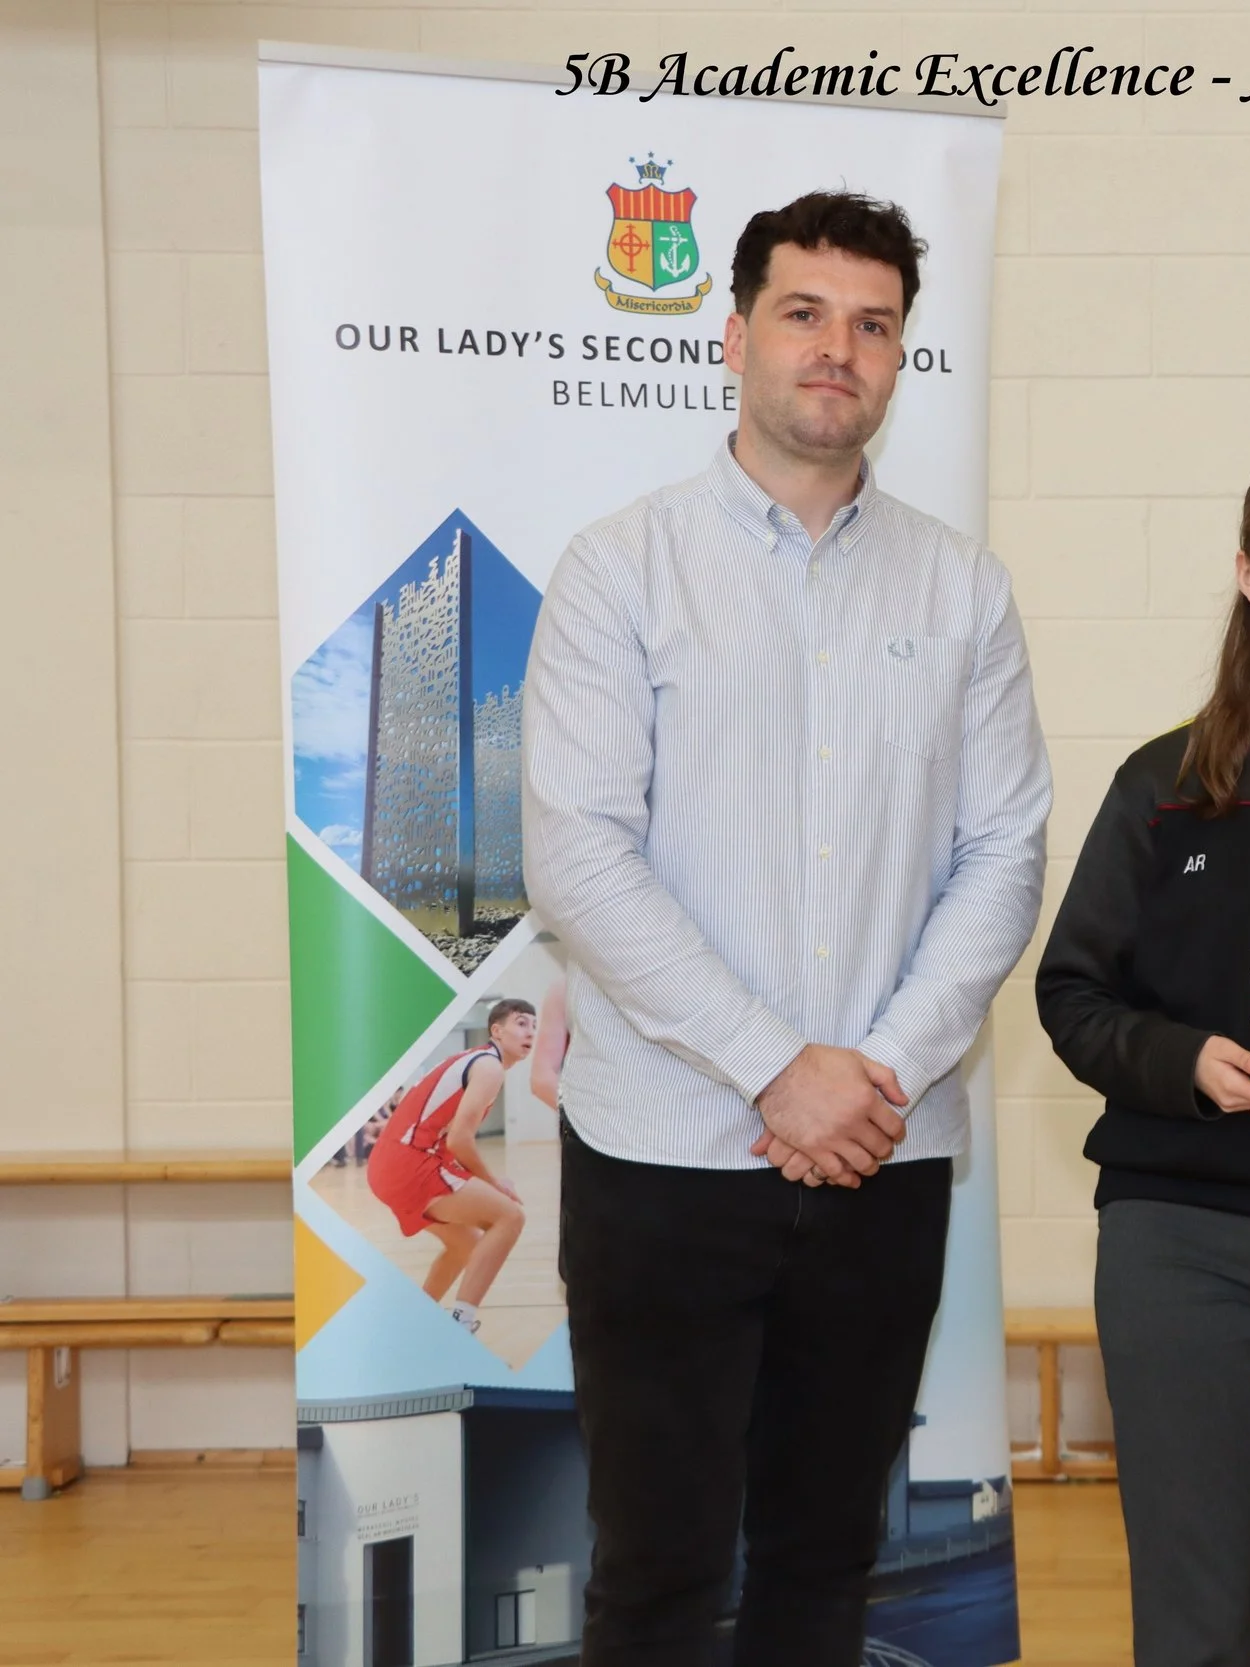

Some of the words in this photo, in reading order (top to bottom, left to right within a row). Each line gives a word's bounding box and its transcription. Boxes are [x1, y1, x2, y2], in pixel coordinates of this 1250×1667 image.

[616, 296, 693, 312] Misericordia
[335, 323, 420, 353] OUR
[438, 327, 565, 360] LADY'S
[582, 334, 725, 365] SECOND
[553, 380, 737, 411] BELMULLE
[1183, 853, 1206, 874] AR
